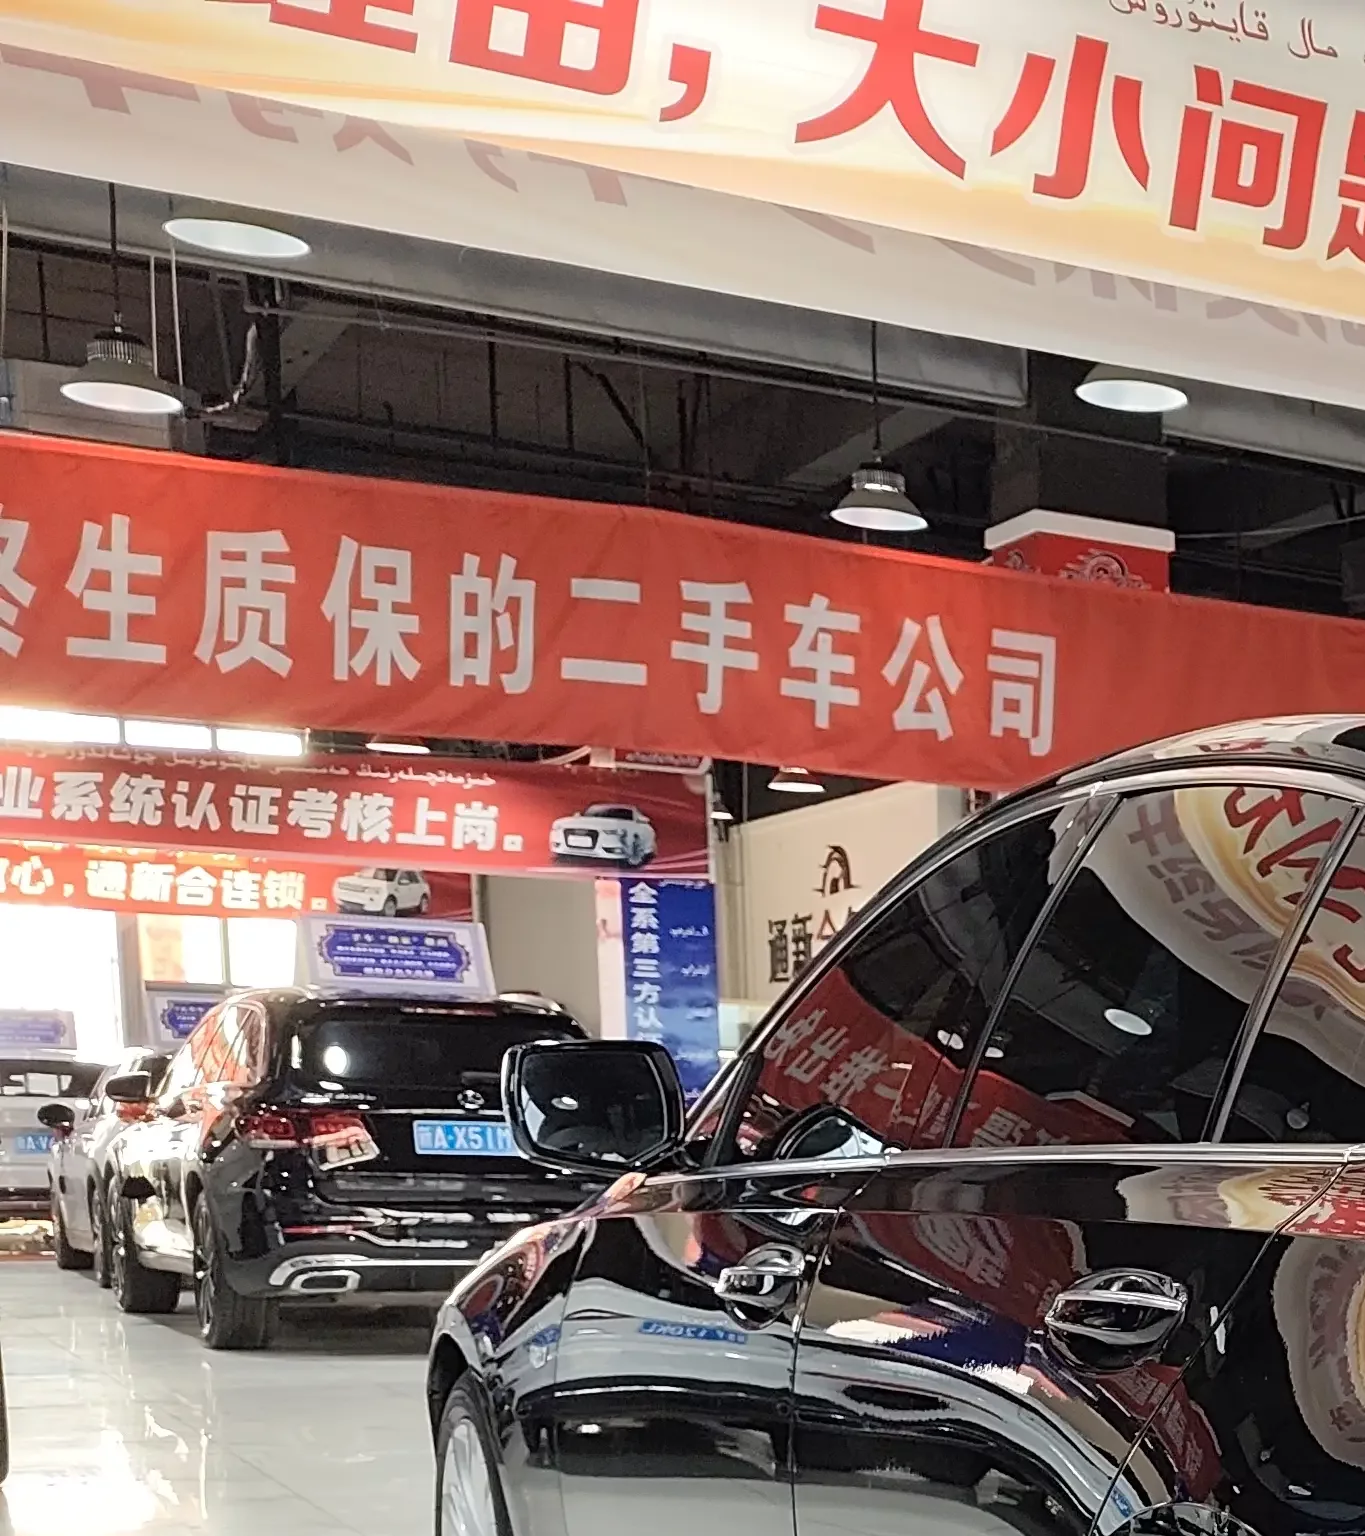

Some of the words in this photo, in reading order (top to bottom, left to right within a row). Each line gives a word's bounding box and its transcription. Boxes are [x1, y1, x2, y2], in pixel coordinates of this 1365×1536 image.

[0, 765, 524, 853] 业系统认证考核上岗。
[0, 856, 328, 912] 心，通新合连锁。
